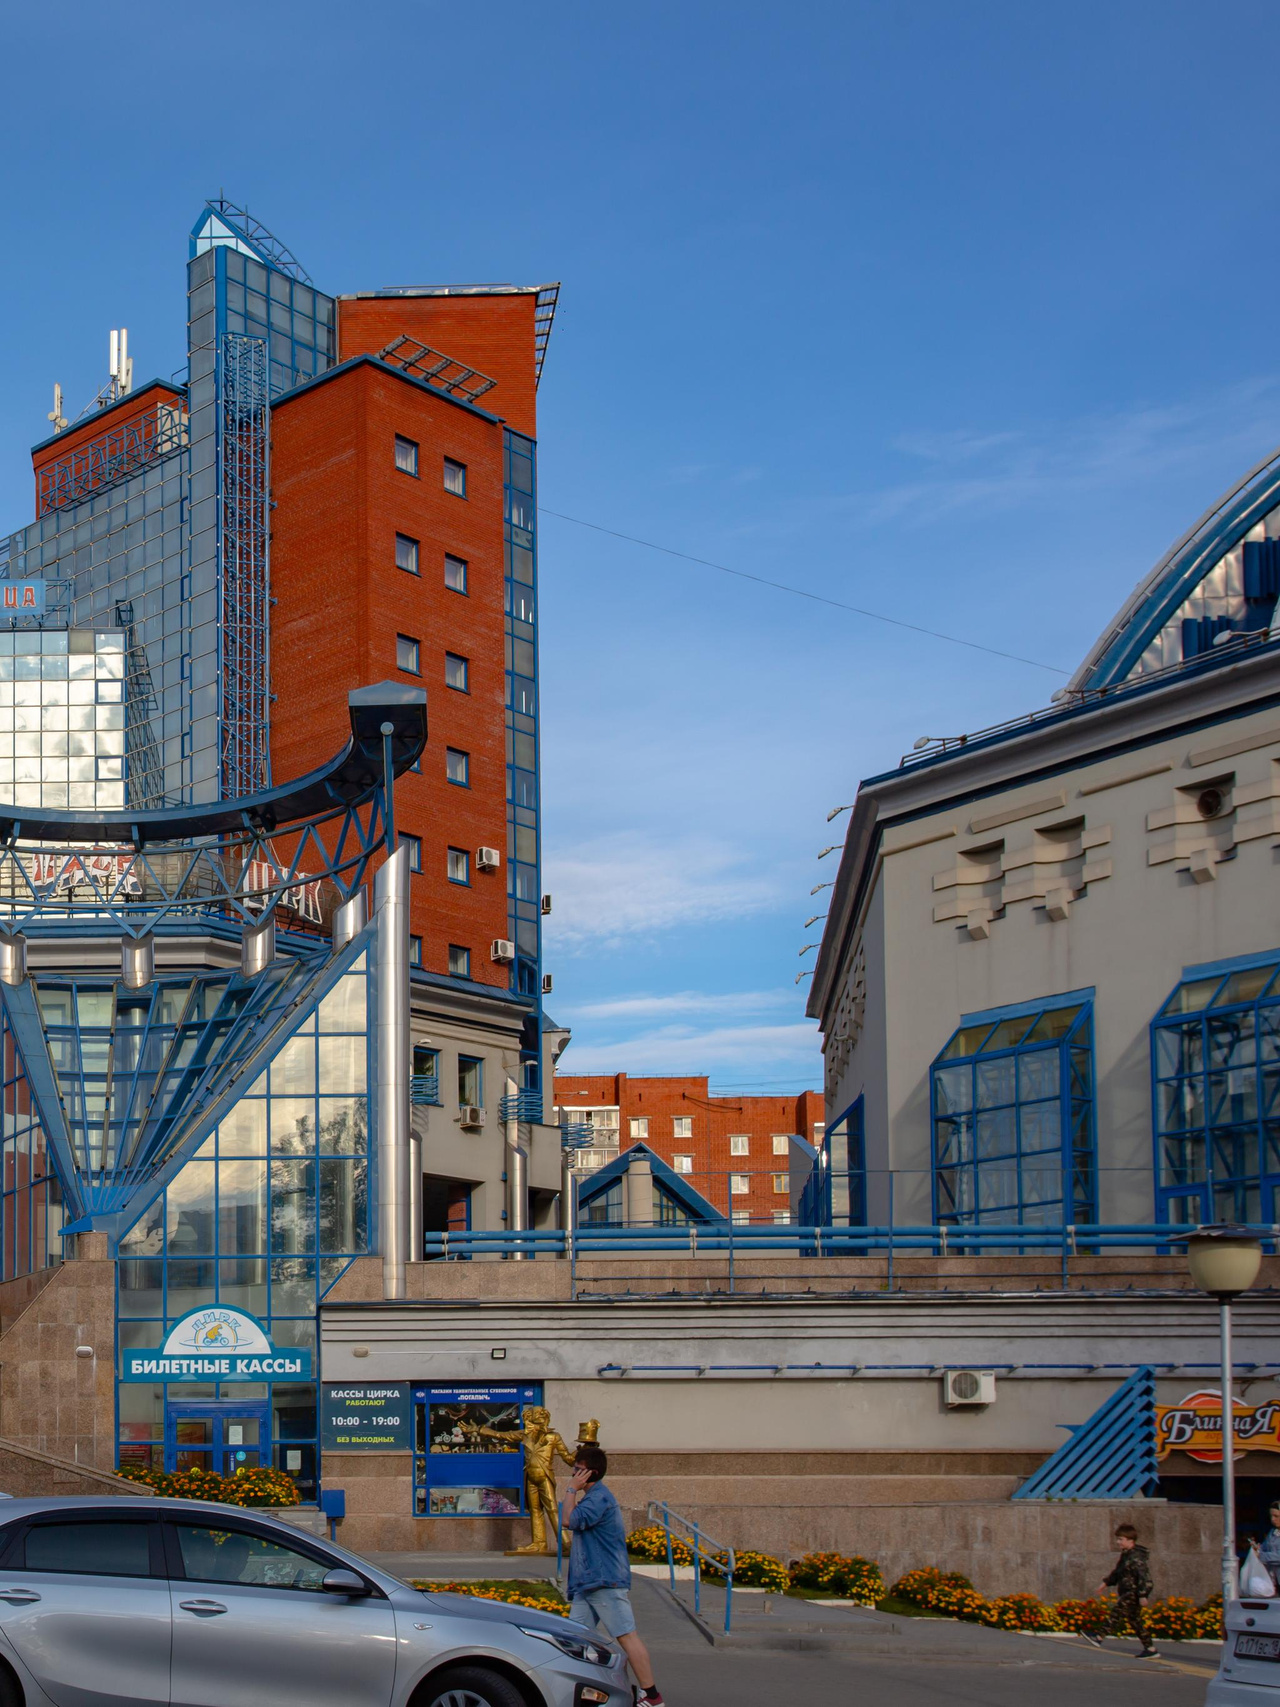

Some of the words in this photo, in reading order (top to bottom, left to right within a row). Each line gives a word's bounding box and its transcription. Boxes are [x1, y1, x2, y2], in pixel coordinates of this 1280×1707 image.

[191, 1311, 241, 1333] ЦИРК
[131, 1359, 230, 1374] БИЛЕТНЫЕ
[236, 1358, 301, 1373] КАССЫ
[331, 1389, 364, 1398] КАССЫ
[366, 1389, 400, 1399] ЦИРКА
[345, 1399, 386, 1407] РАБОТАЮТ
[331, 1416, 360, 1426] 10:00
[371, 1416, 400, 1426] 19:00
[351, 1436, 395, 1444] ВЫХОДНЫХ
